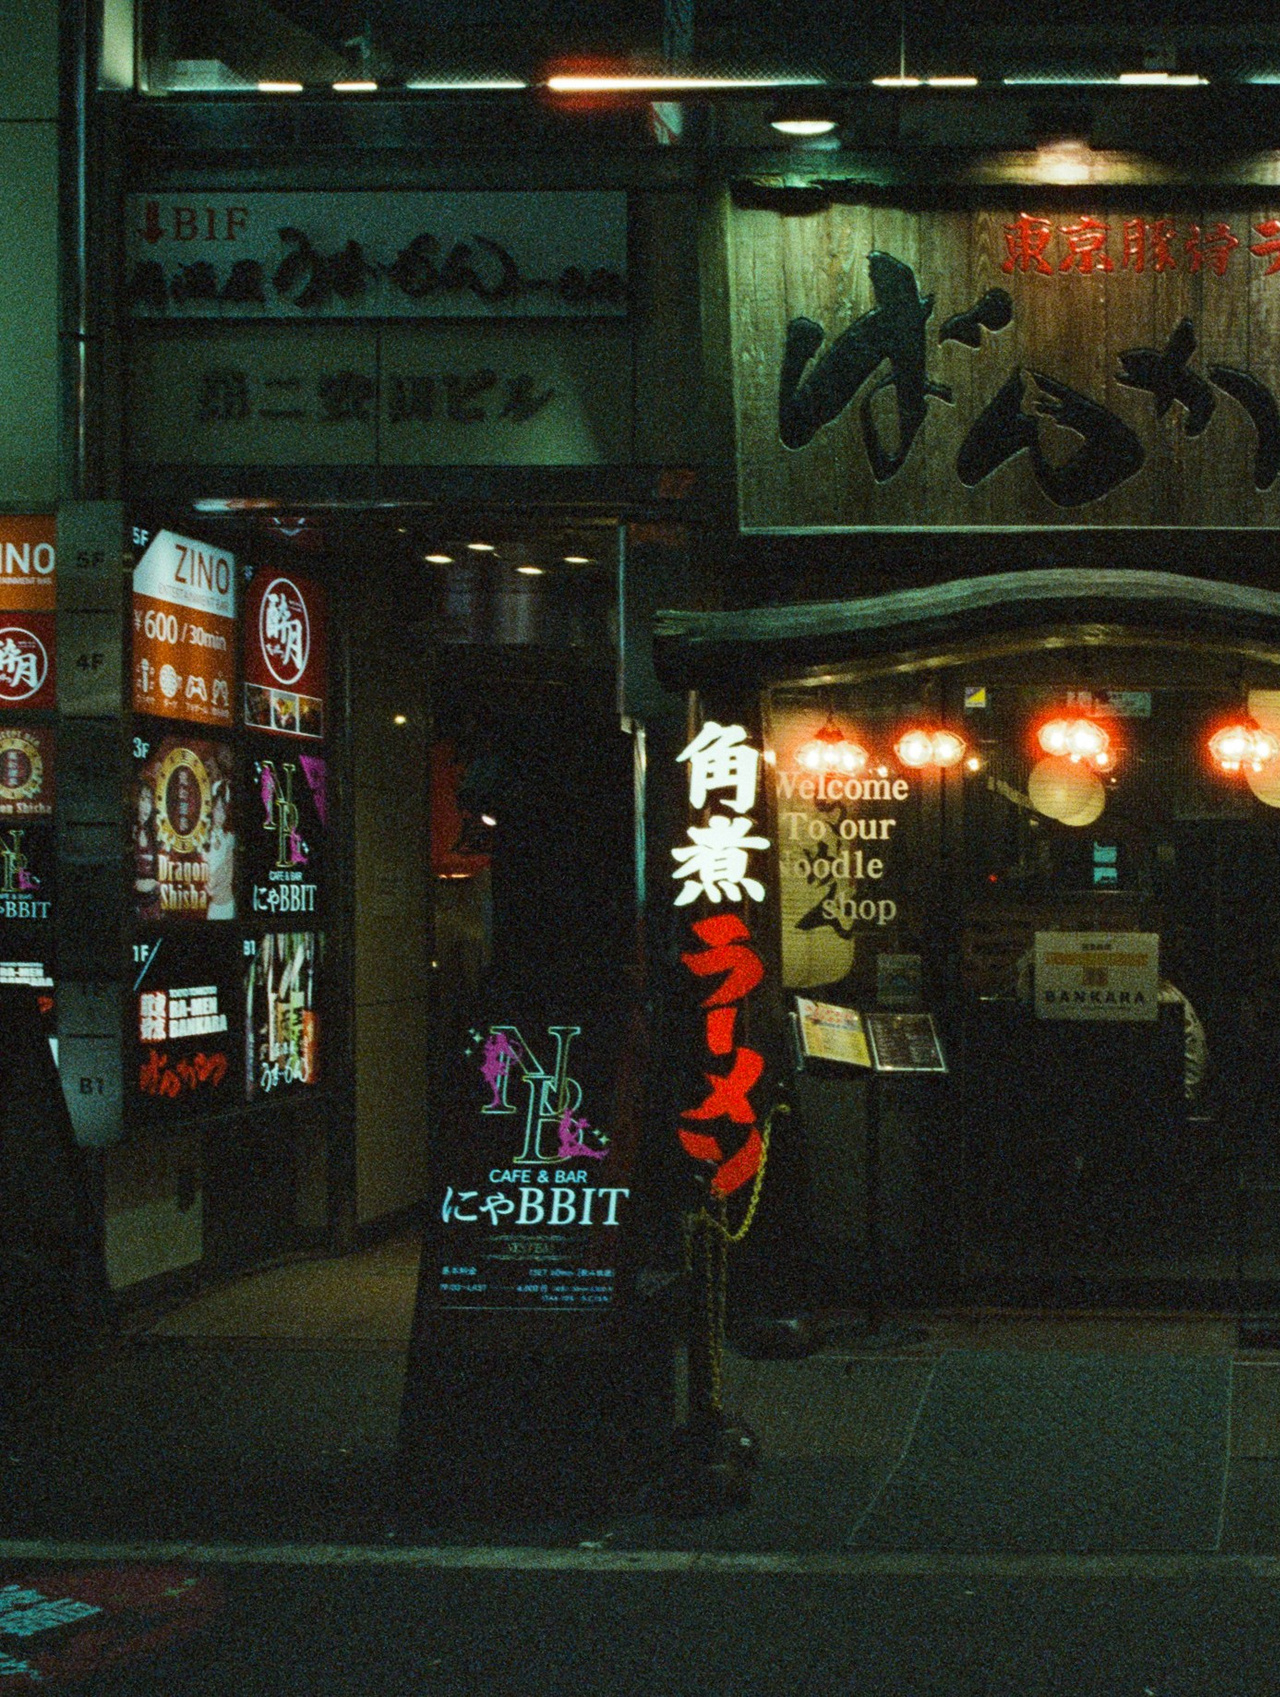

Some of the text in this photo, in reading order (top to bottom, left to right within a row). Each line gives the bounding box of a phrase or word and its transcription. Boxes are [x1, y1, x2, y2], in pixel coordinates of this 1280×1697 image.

[76, 551, 104, 568] 5F
[173, 543, 230, 595] ZINO
[76, 652, 104, 669] 4F
[133, 737, 149, 758] 3F
[775, 771, 910, 801] Welcome
[784, 811, 897, 841] To our
[157, 855, 209, 882] Dragon
[159, 884, 208, 911] Shisha
[821, 890, 898, 925] shop
[132, 944, 149, 962] 1F
[1045, 989, 1146, 1004] BANKARA
[79, 1076, 105, 1095] B1
[489, 1169, 588, 1184] CAFE & BAR
